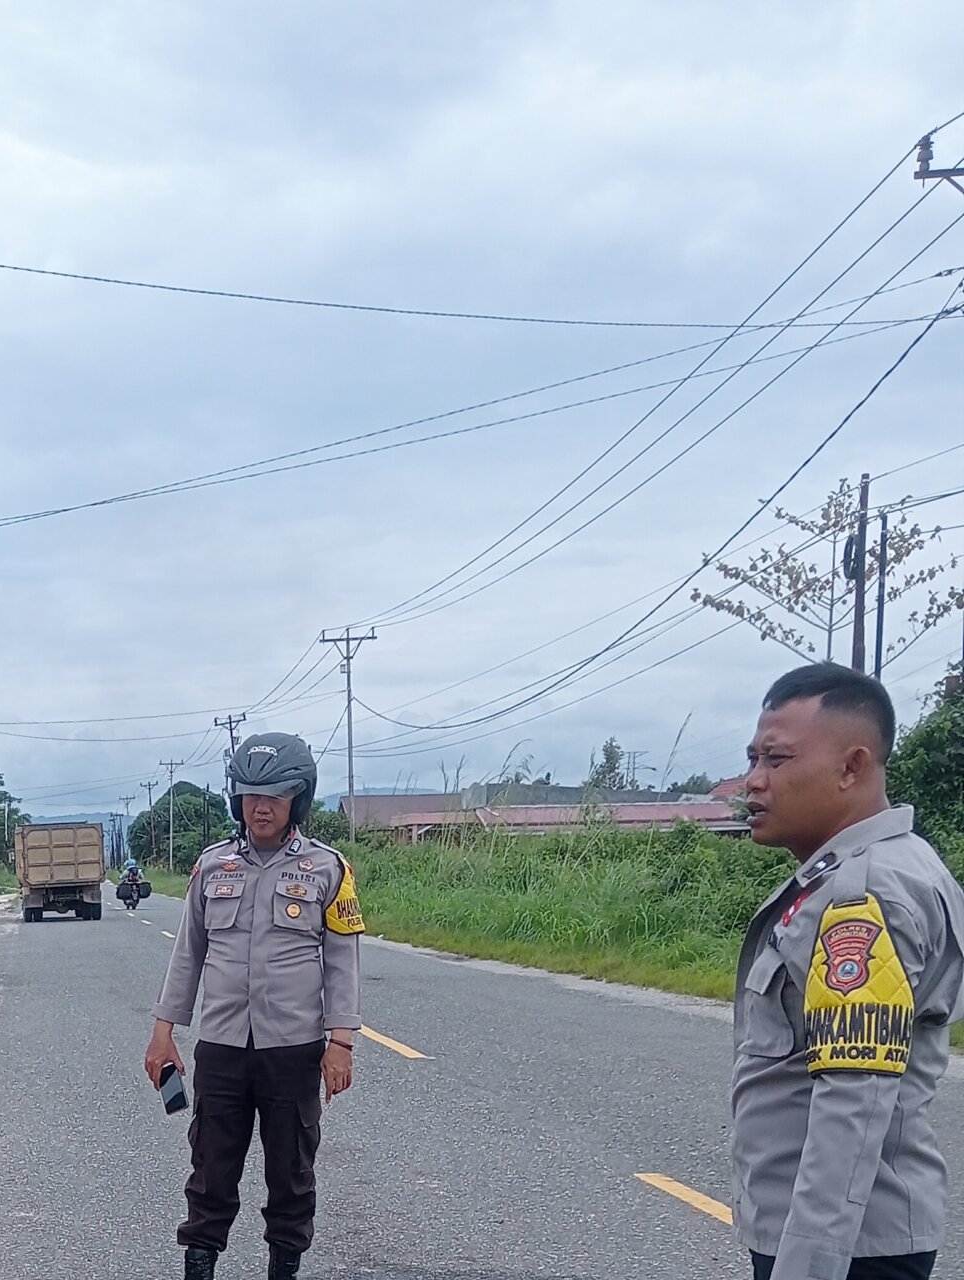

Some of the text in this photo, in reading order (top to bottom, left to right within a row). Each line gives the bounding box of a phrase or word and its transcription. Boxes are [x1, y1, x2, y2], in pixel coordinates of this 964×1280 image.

[281, 871, 316, 882] POLISI
[830, 1045, 878, 1061] MORI
[883, 1046, 909, 1064] ATA
